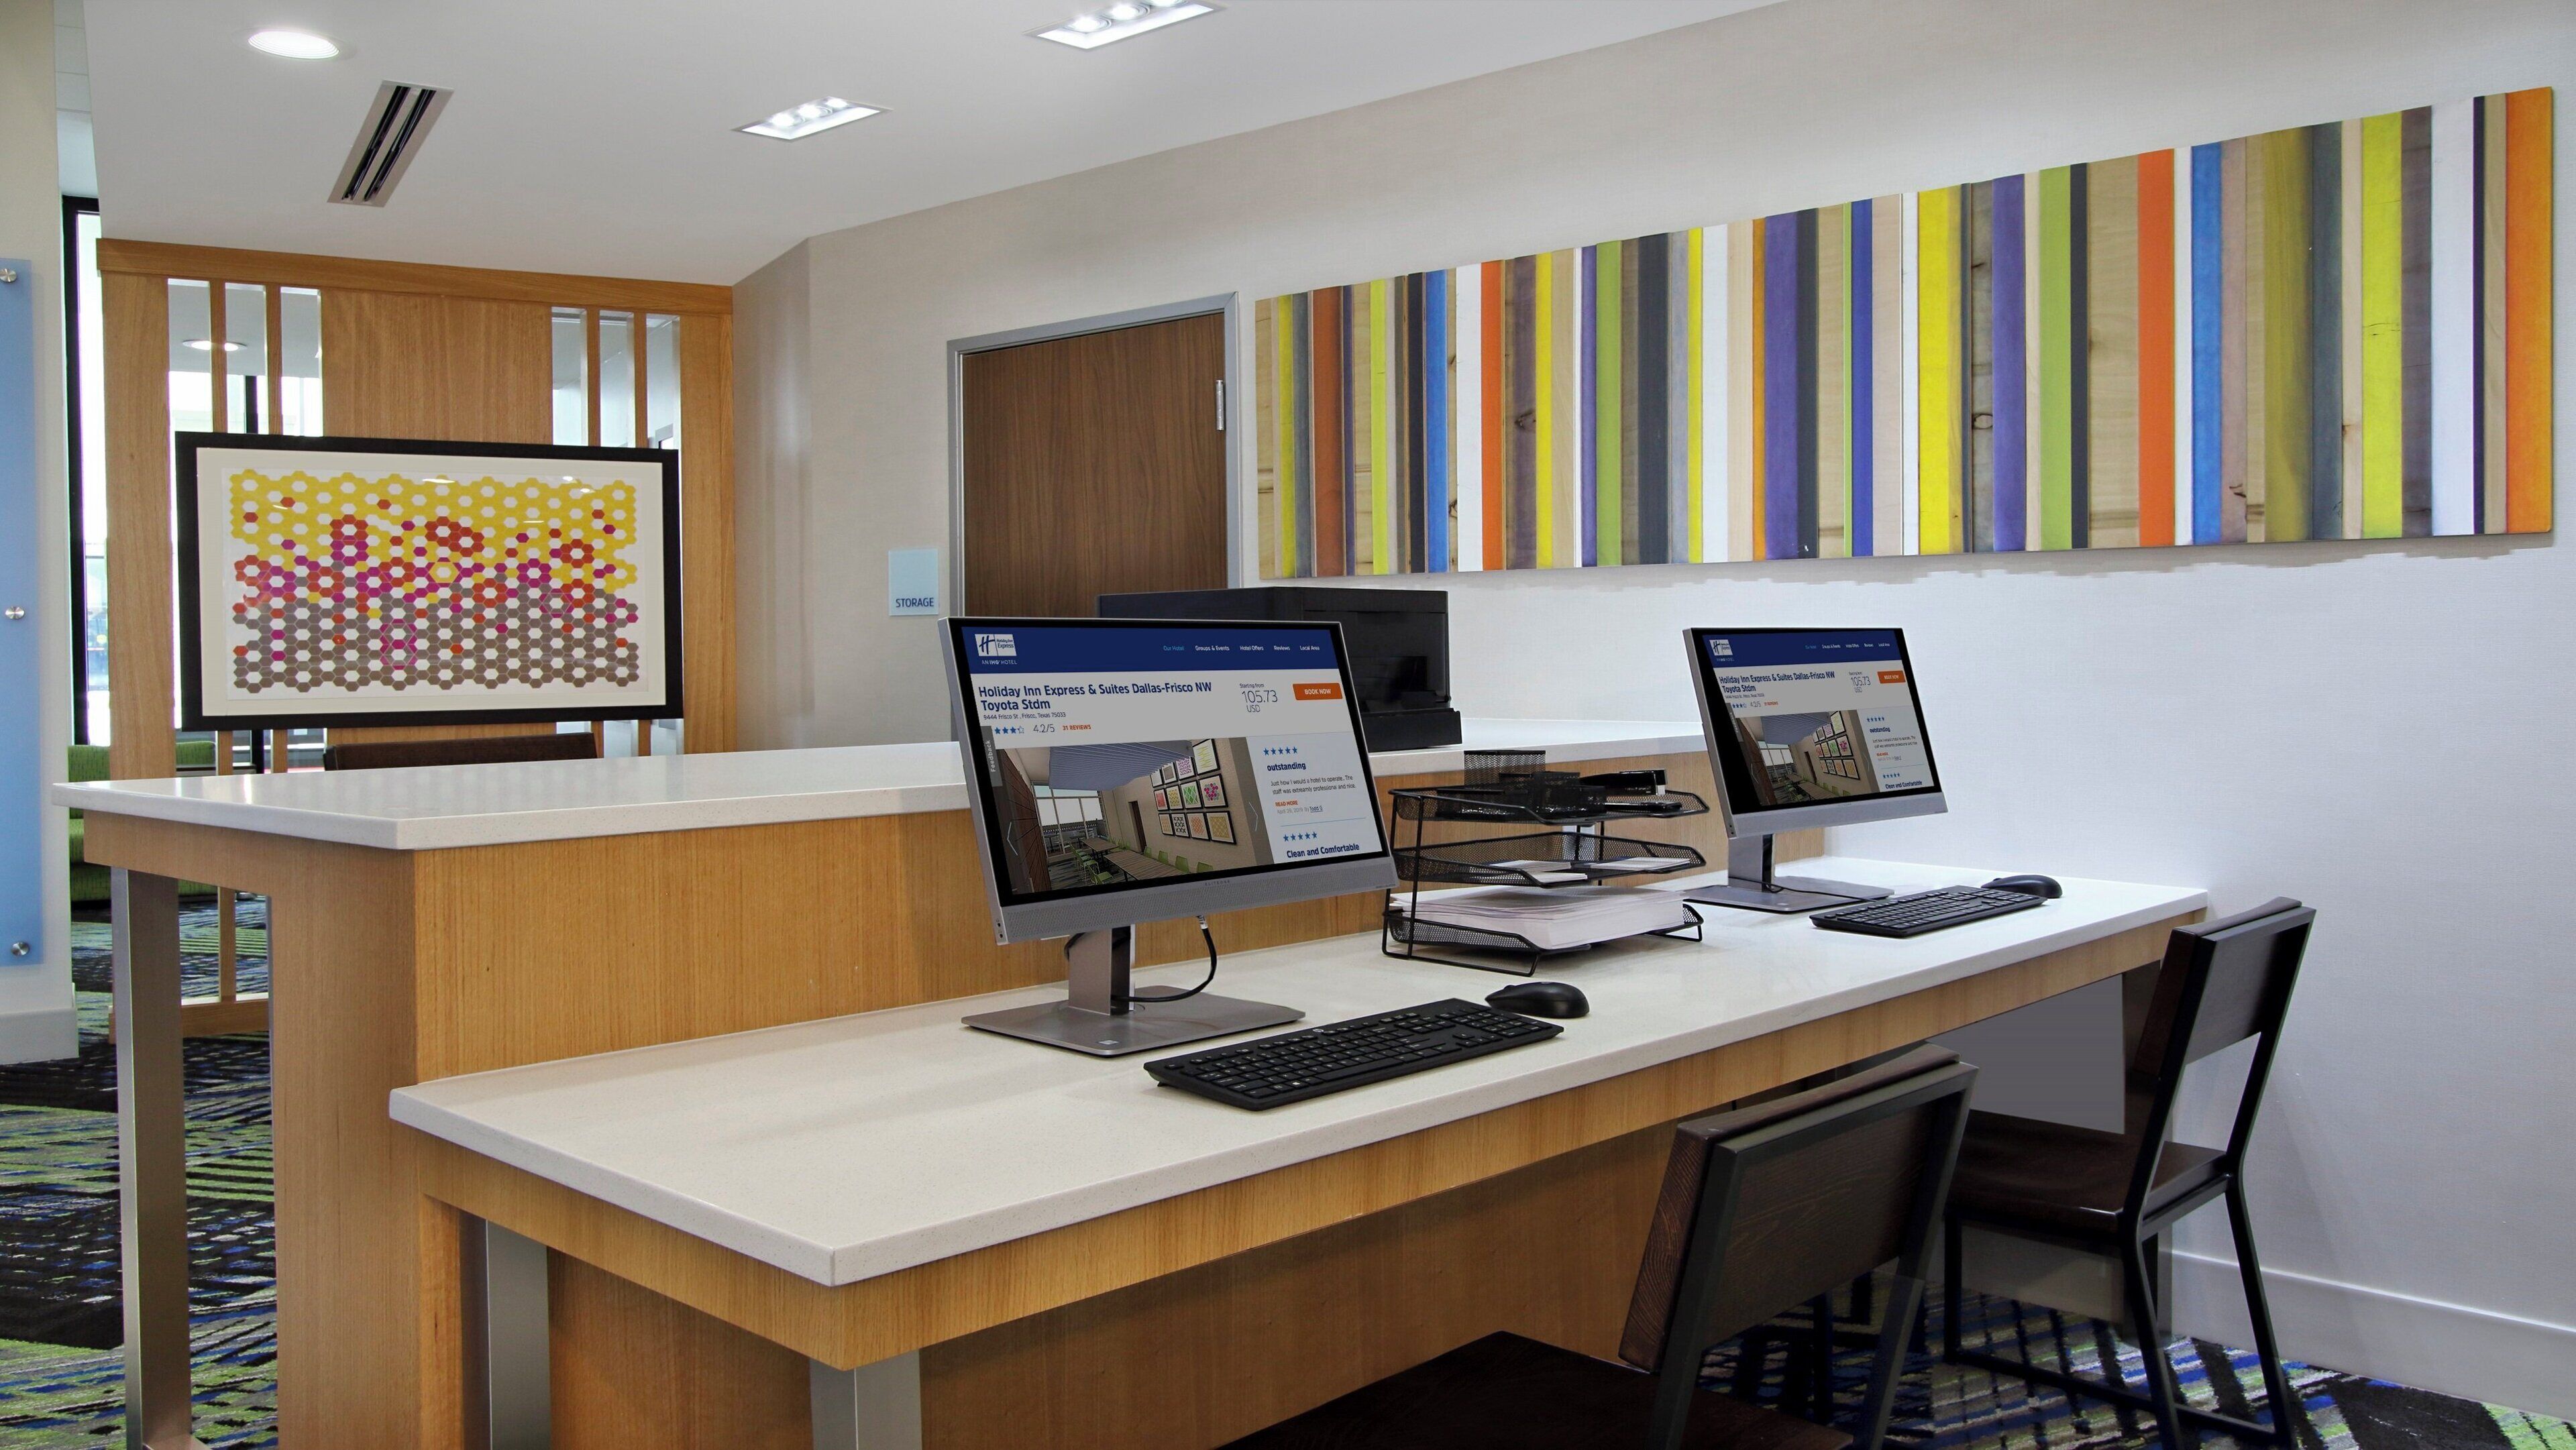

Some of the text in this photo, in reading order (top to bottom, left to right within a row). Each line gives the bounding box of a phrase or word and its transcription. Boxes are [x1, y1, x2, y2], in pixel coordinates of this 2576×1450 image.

[896, 597, 934, 608] STORAGE
[1719, 676, 1740, 684] Holiday
[1750, 675, 1771, 683] Express
[1793, 672, 1825, 680] Dallas-Frisco
[1851, 676, 1871, 686] 105.73
[978, 681, 1212, 698] Holiday Inn Express & Suites Dallas-Frisco NW
[1722, 685, 1741, 693] Toyota
[1242, 689, 1278, 703] 105.73
[981, 699, 1051, 712] Toyota Stdm
[1246, 704, 1260, 712] USD
[1033, 724, 1055, 733] 4.2/5
[985, 740, 996, 772] Feedback
[1267, 762, 1306, 771] outstanding
[1287, 843, 1360, 858] Clean and Comfortable
